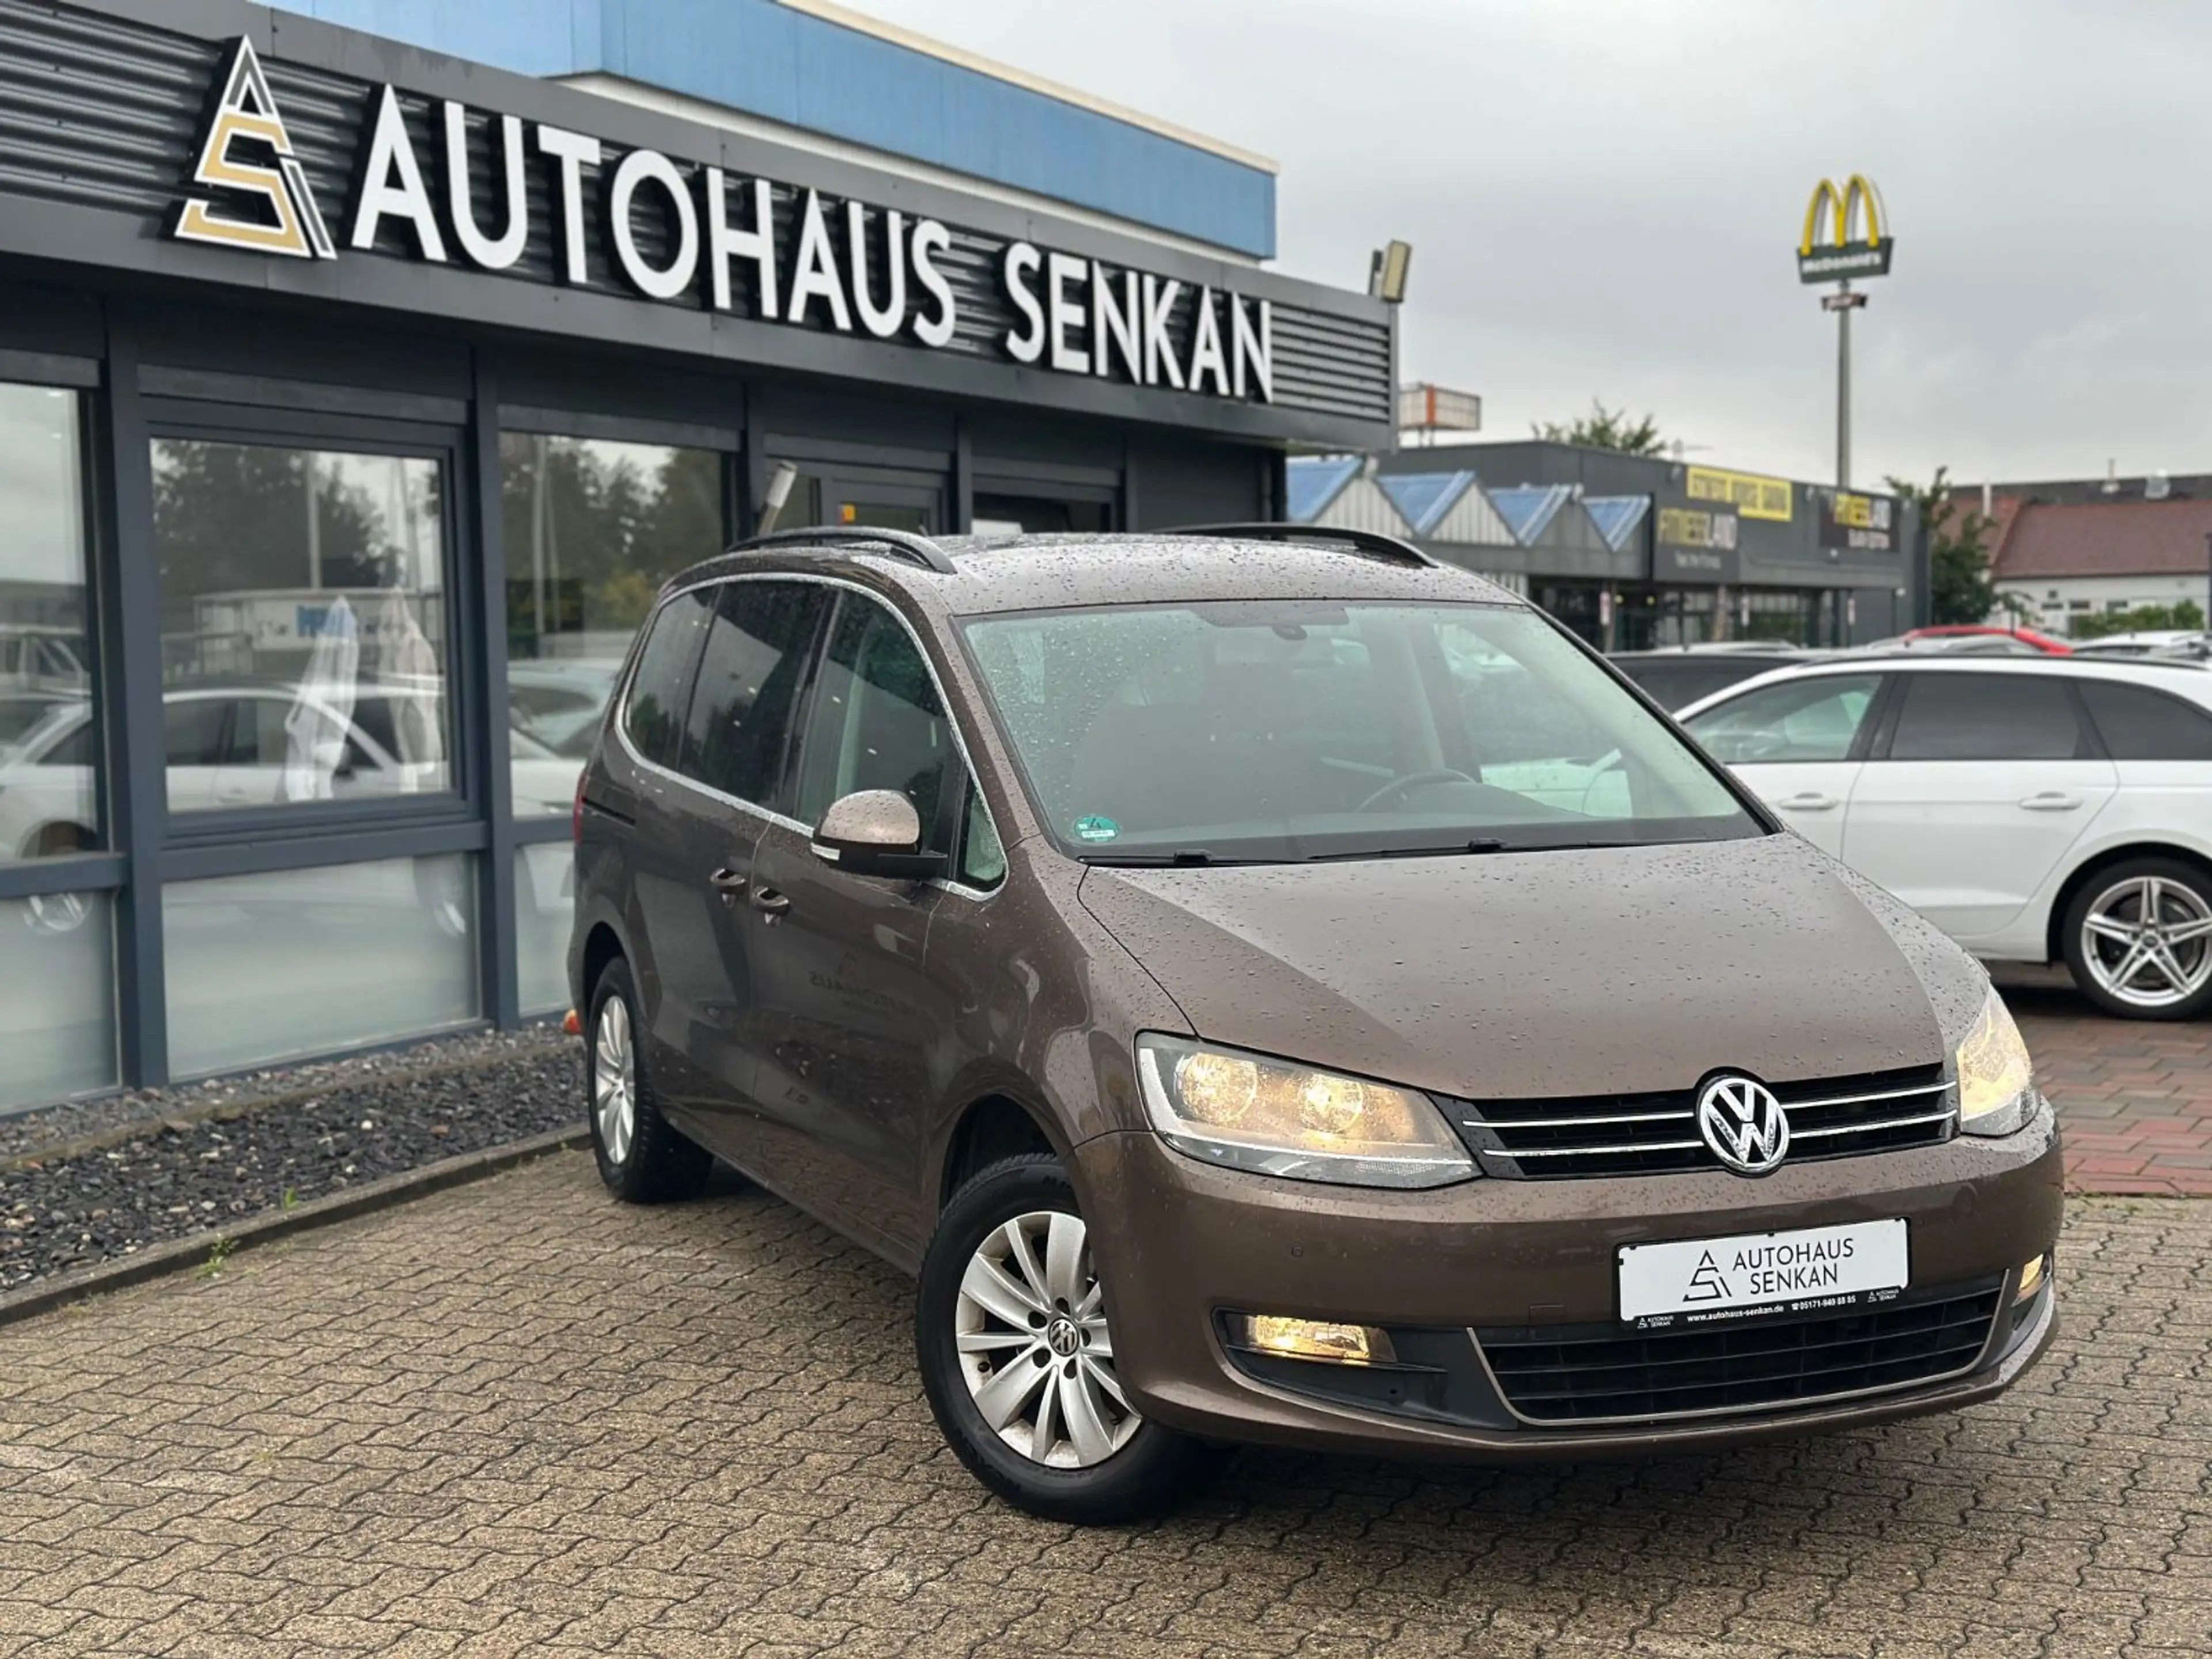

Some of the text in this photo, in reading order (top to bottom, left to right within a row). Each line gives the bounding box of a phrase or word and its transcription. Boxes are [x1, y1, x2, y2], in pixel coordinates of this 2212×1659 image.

[351, 82, 1272, 403] AUTOHAUS SENKAN
[1732, 1238, 1854, 1271] AUTOHAUS
[1749, 1263, 1838, 1295] SENKAN
